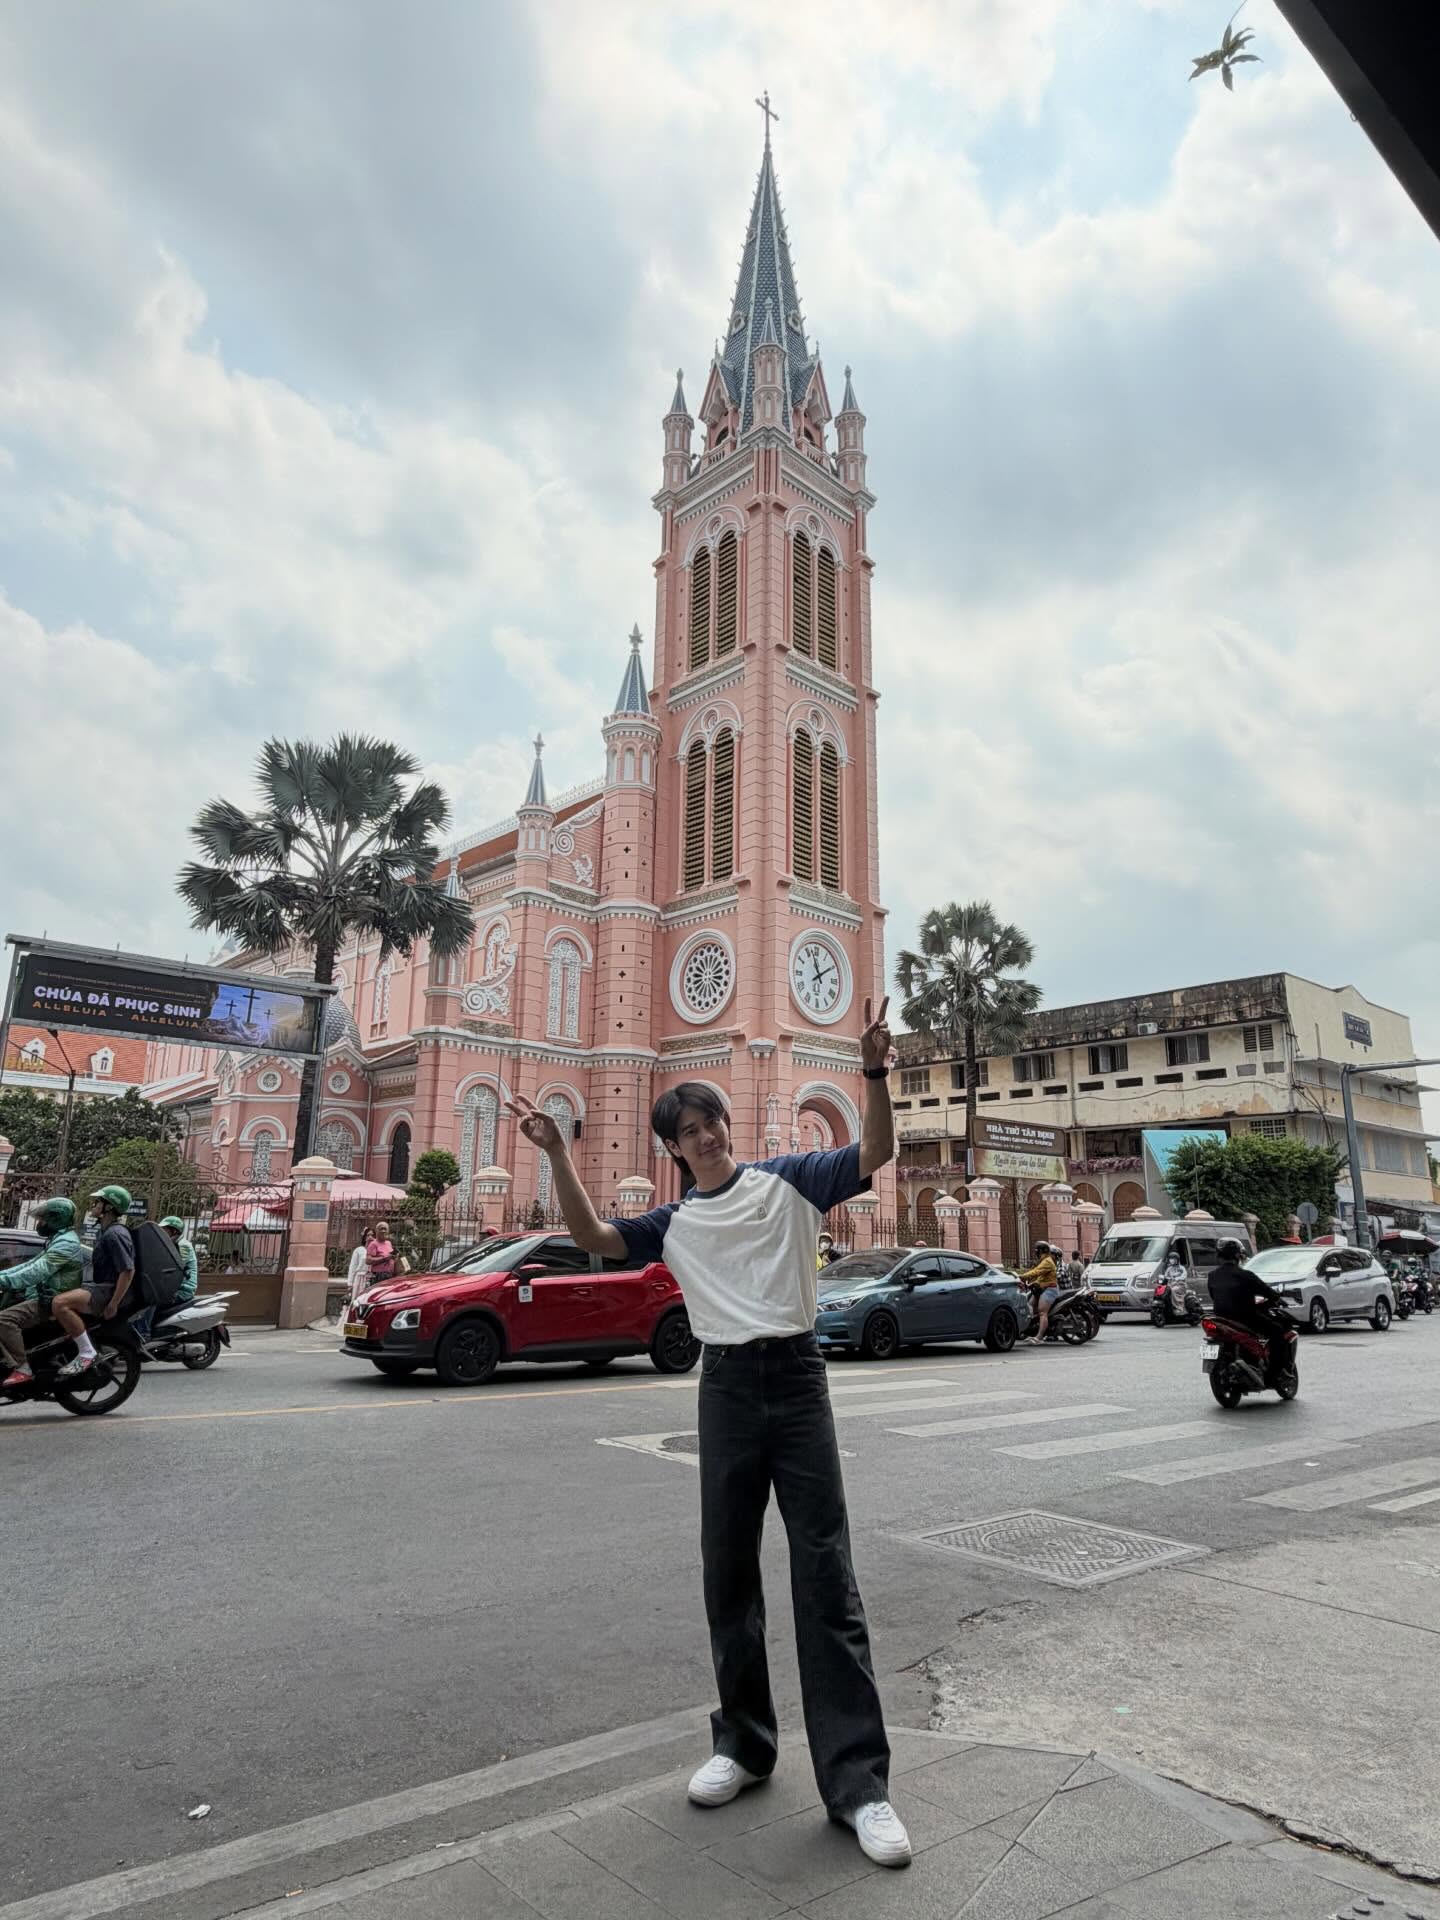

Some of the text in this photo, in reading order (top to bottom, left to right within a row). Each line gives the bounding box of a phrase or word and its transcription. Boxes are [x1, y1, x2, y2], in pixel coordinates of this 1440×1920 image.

[32, 1001, 107, 1017] ALLELUIA
[130, 1013, 199, 1029] ALLELUIA
[34, 985, 201, 1019] CHÚA ĐÃ PHỤC SINH
[986, 1124, 1003, 1133] NHÀ
[1021, 1128, 1036, 1137] TÂN
